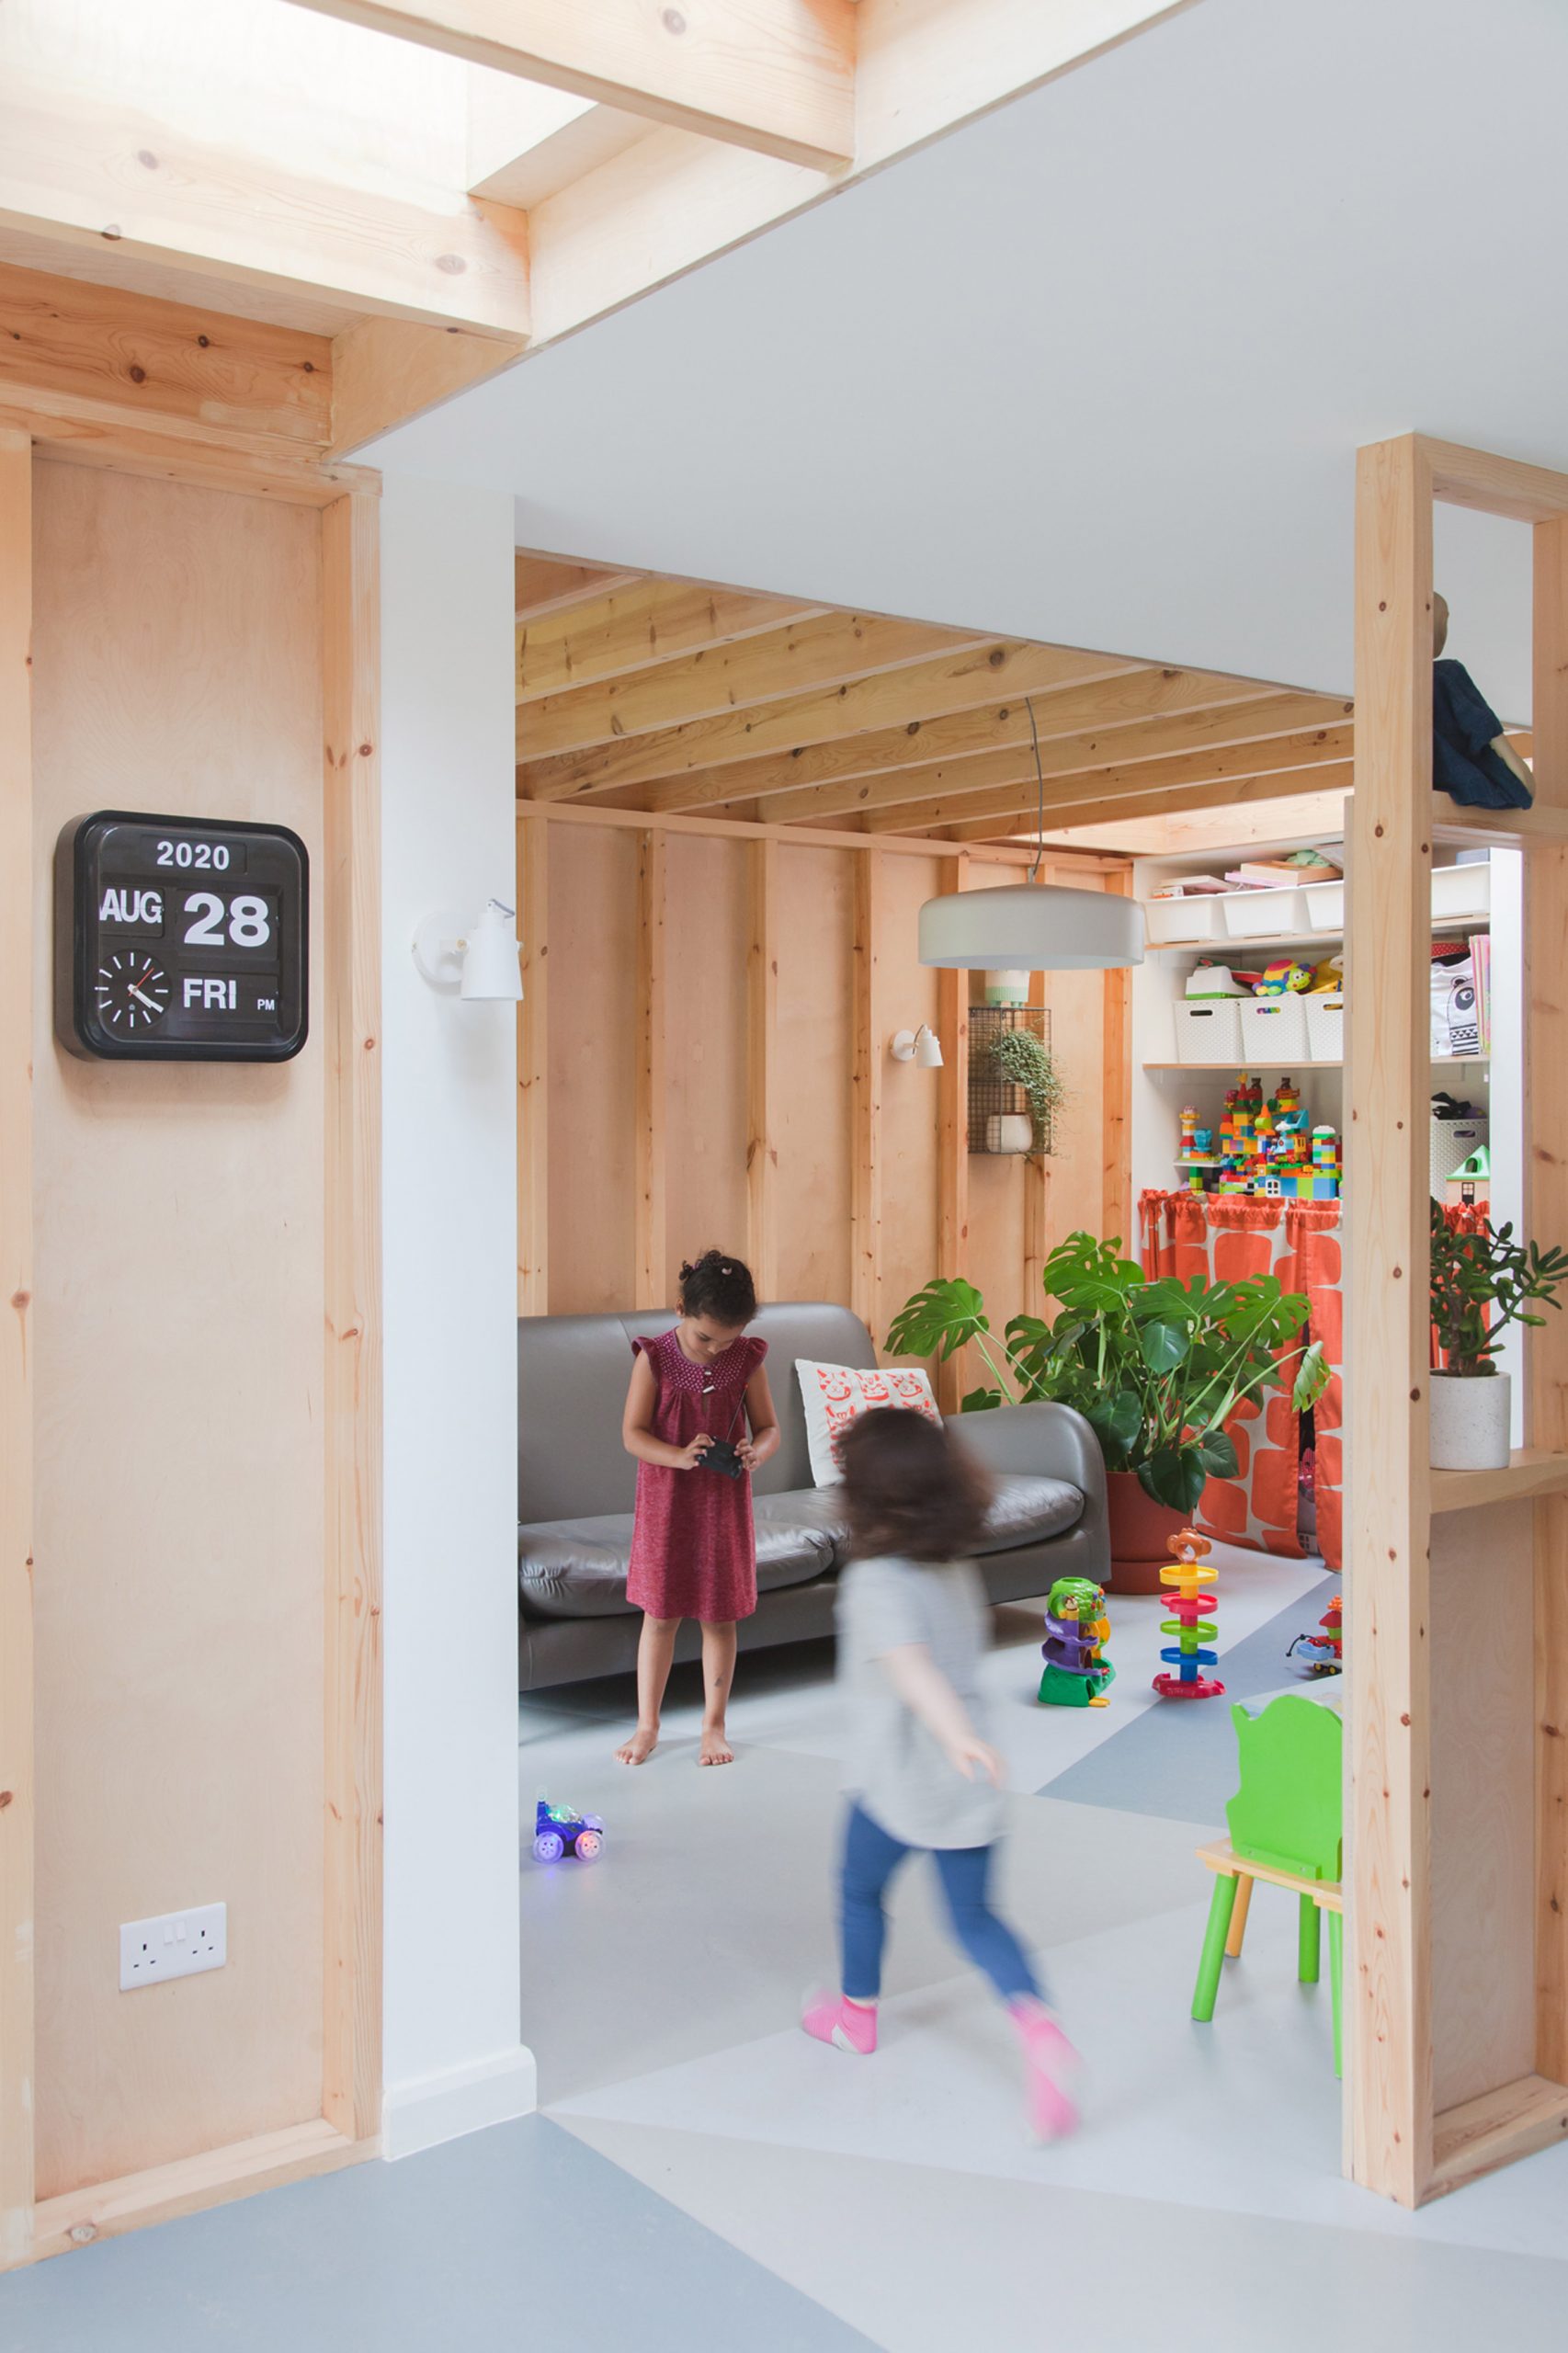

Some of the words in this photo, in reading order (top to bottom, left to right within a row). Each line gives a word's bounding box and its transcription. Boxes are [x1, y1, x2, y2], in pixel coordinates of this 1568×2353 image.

[156, 840, 230, 870] 2020
[98, 888, 163, 924] AUG
[183, 892, 270, 948] 28
[183, 978, 236, 1009] FRI
[256, 998, 275, 1011] PM
